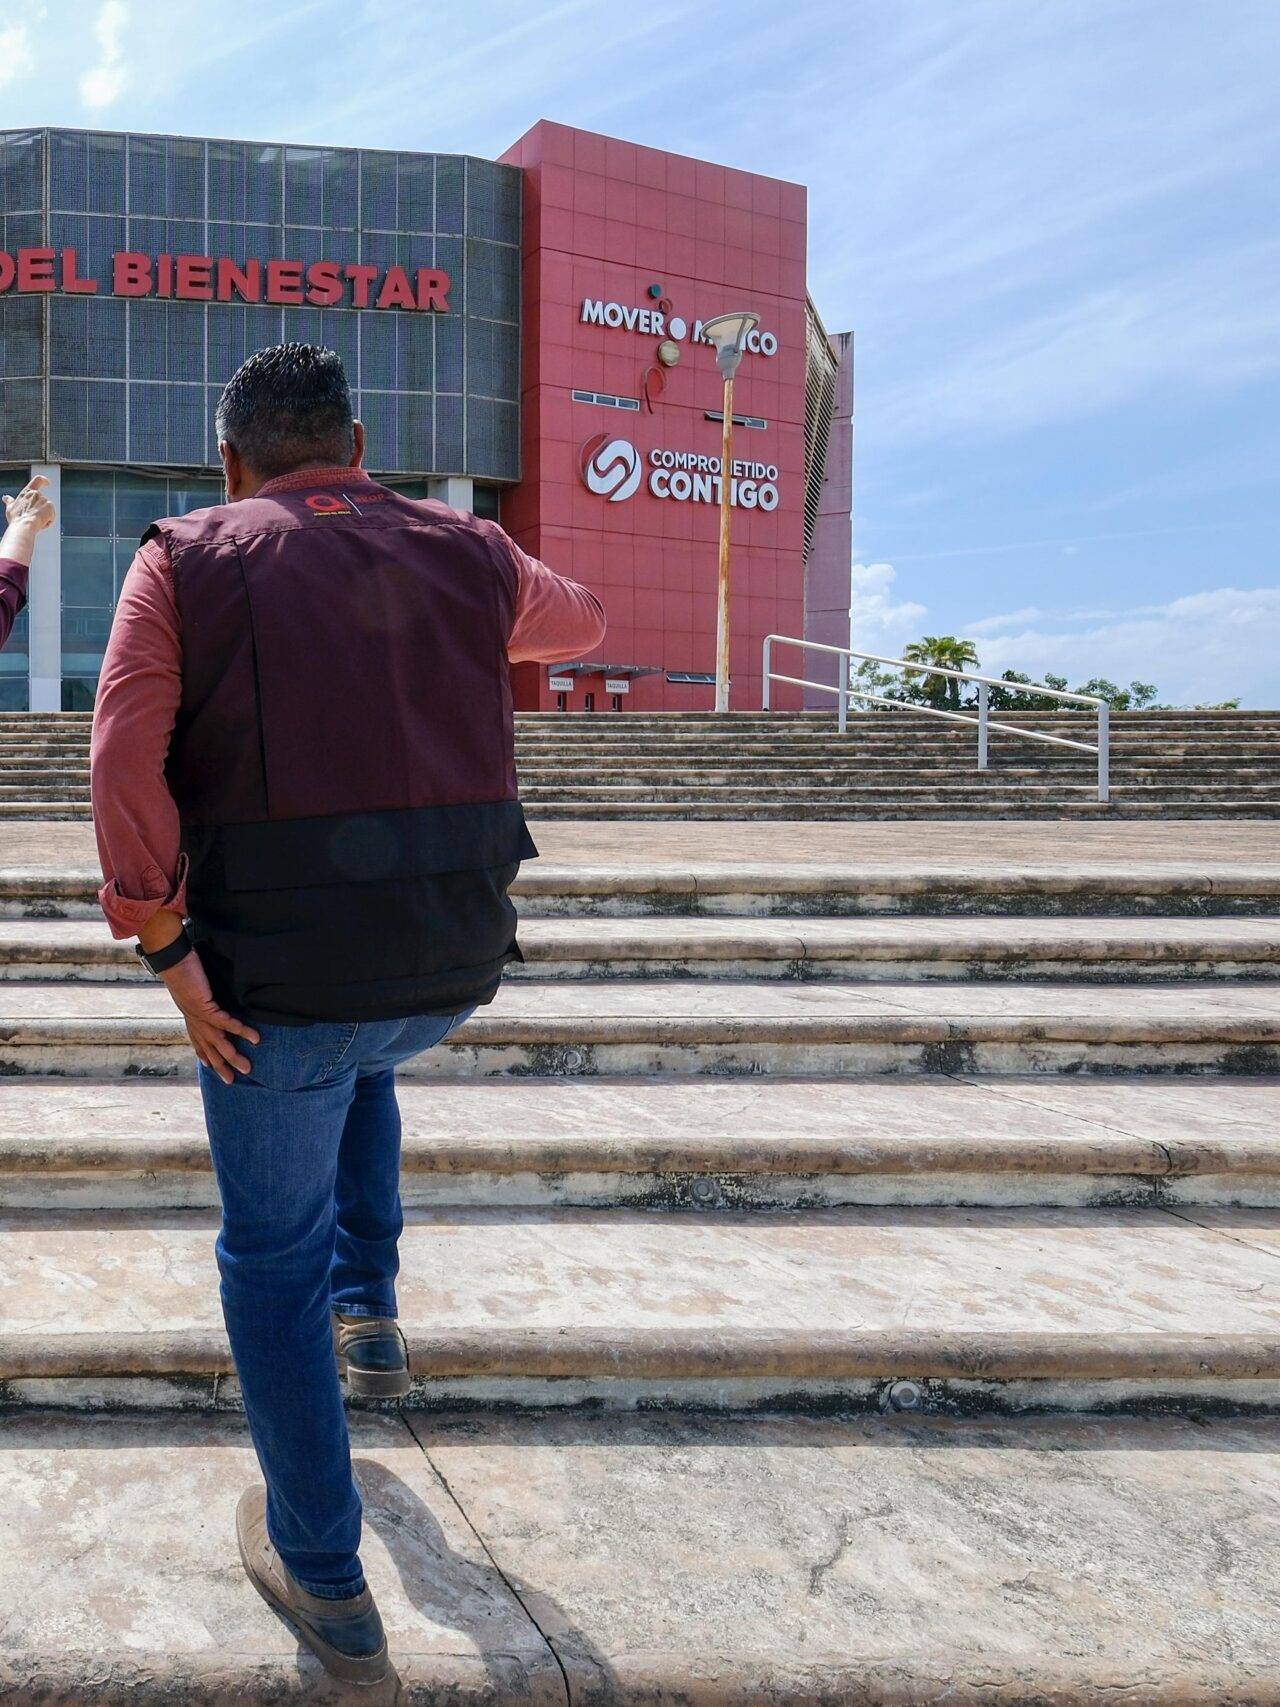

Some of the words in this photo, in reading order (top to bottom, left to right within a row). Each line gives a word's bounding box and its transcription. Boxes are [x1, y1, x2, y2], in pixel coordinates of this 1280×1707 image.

[113, 251, 452, 312] BIENESTAR
[582, 298, 665, 337] MOVER
[649, 469, 779, 512] CONTIGO
